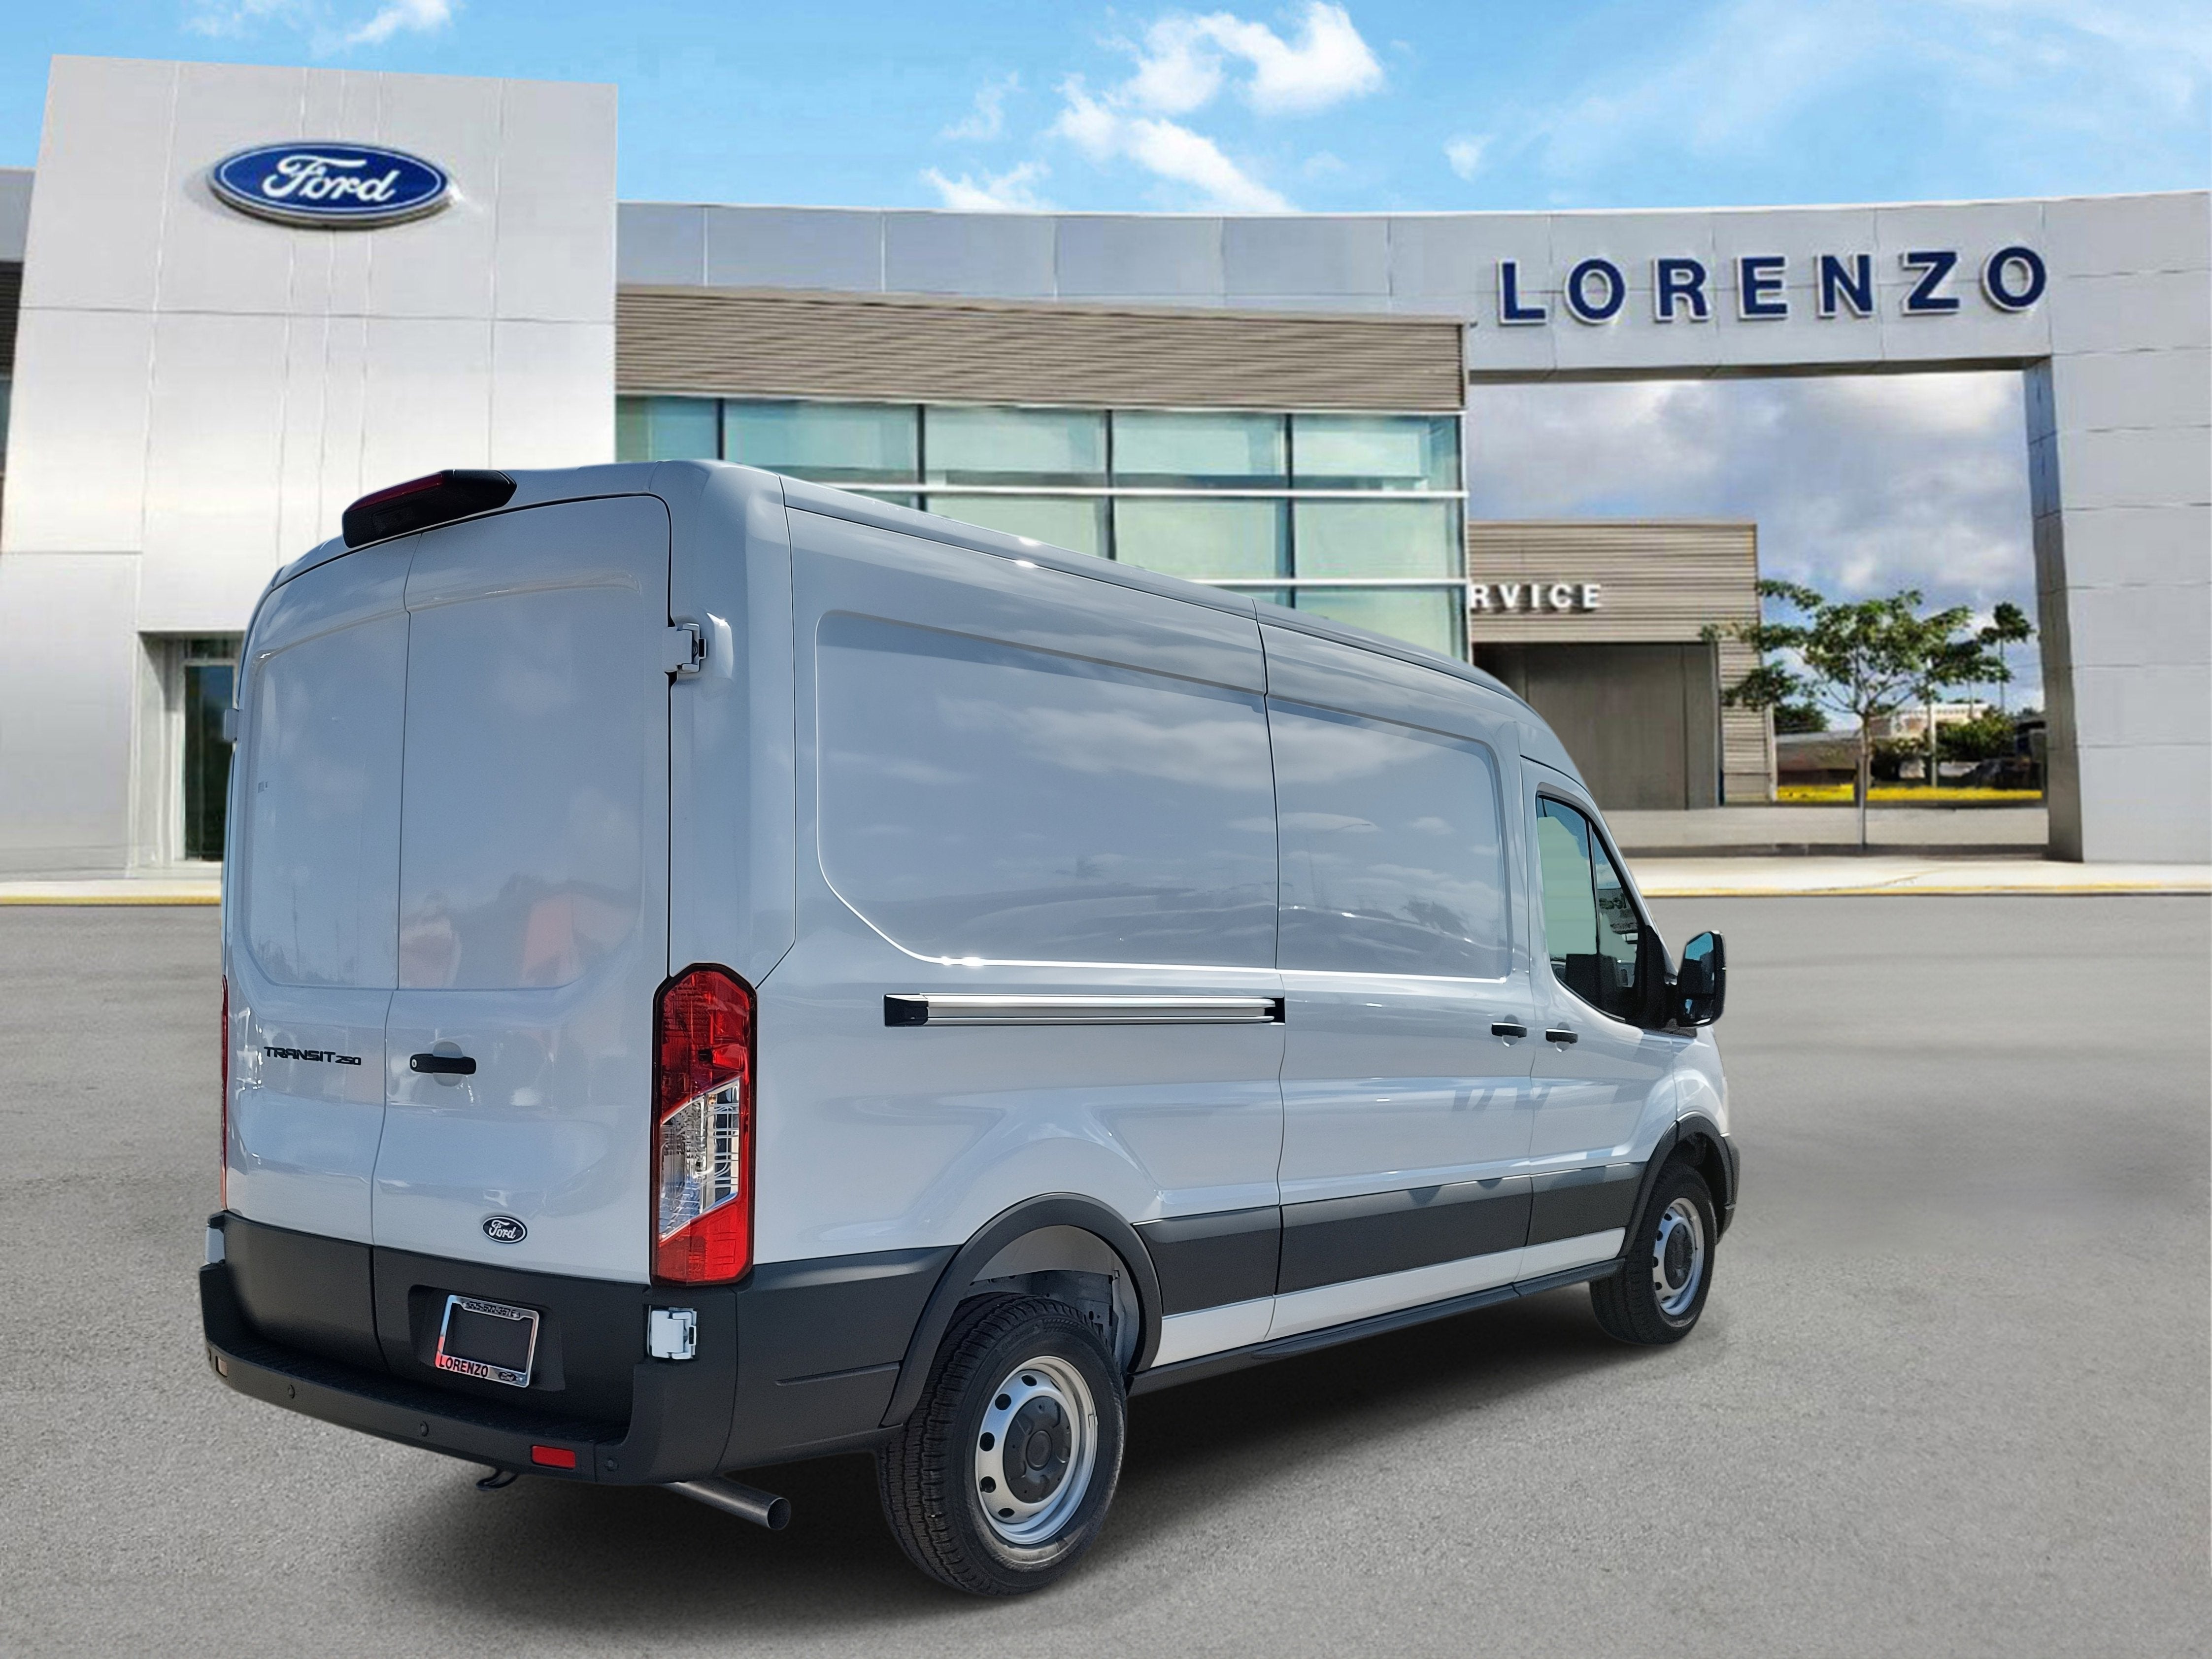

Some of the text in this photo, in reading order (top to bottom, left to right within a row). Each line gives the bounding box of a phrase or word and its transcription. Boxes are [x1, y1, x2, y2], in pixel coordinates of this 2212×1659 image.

[262, 154, 401, 202] Ford
[1497, 245, 2048, 326] LORENZO
[264, 1046, 362, 1066] TRANSIT 250
[488, 1219, 517, 1239] Ford
[438, 1355, 489, 1378] LORENZO
